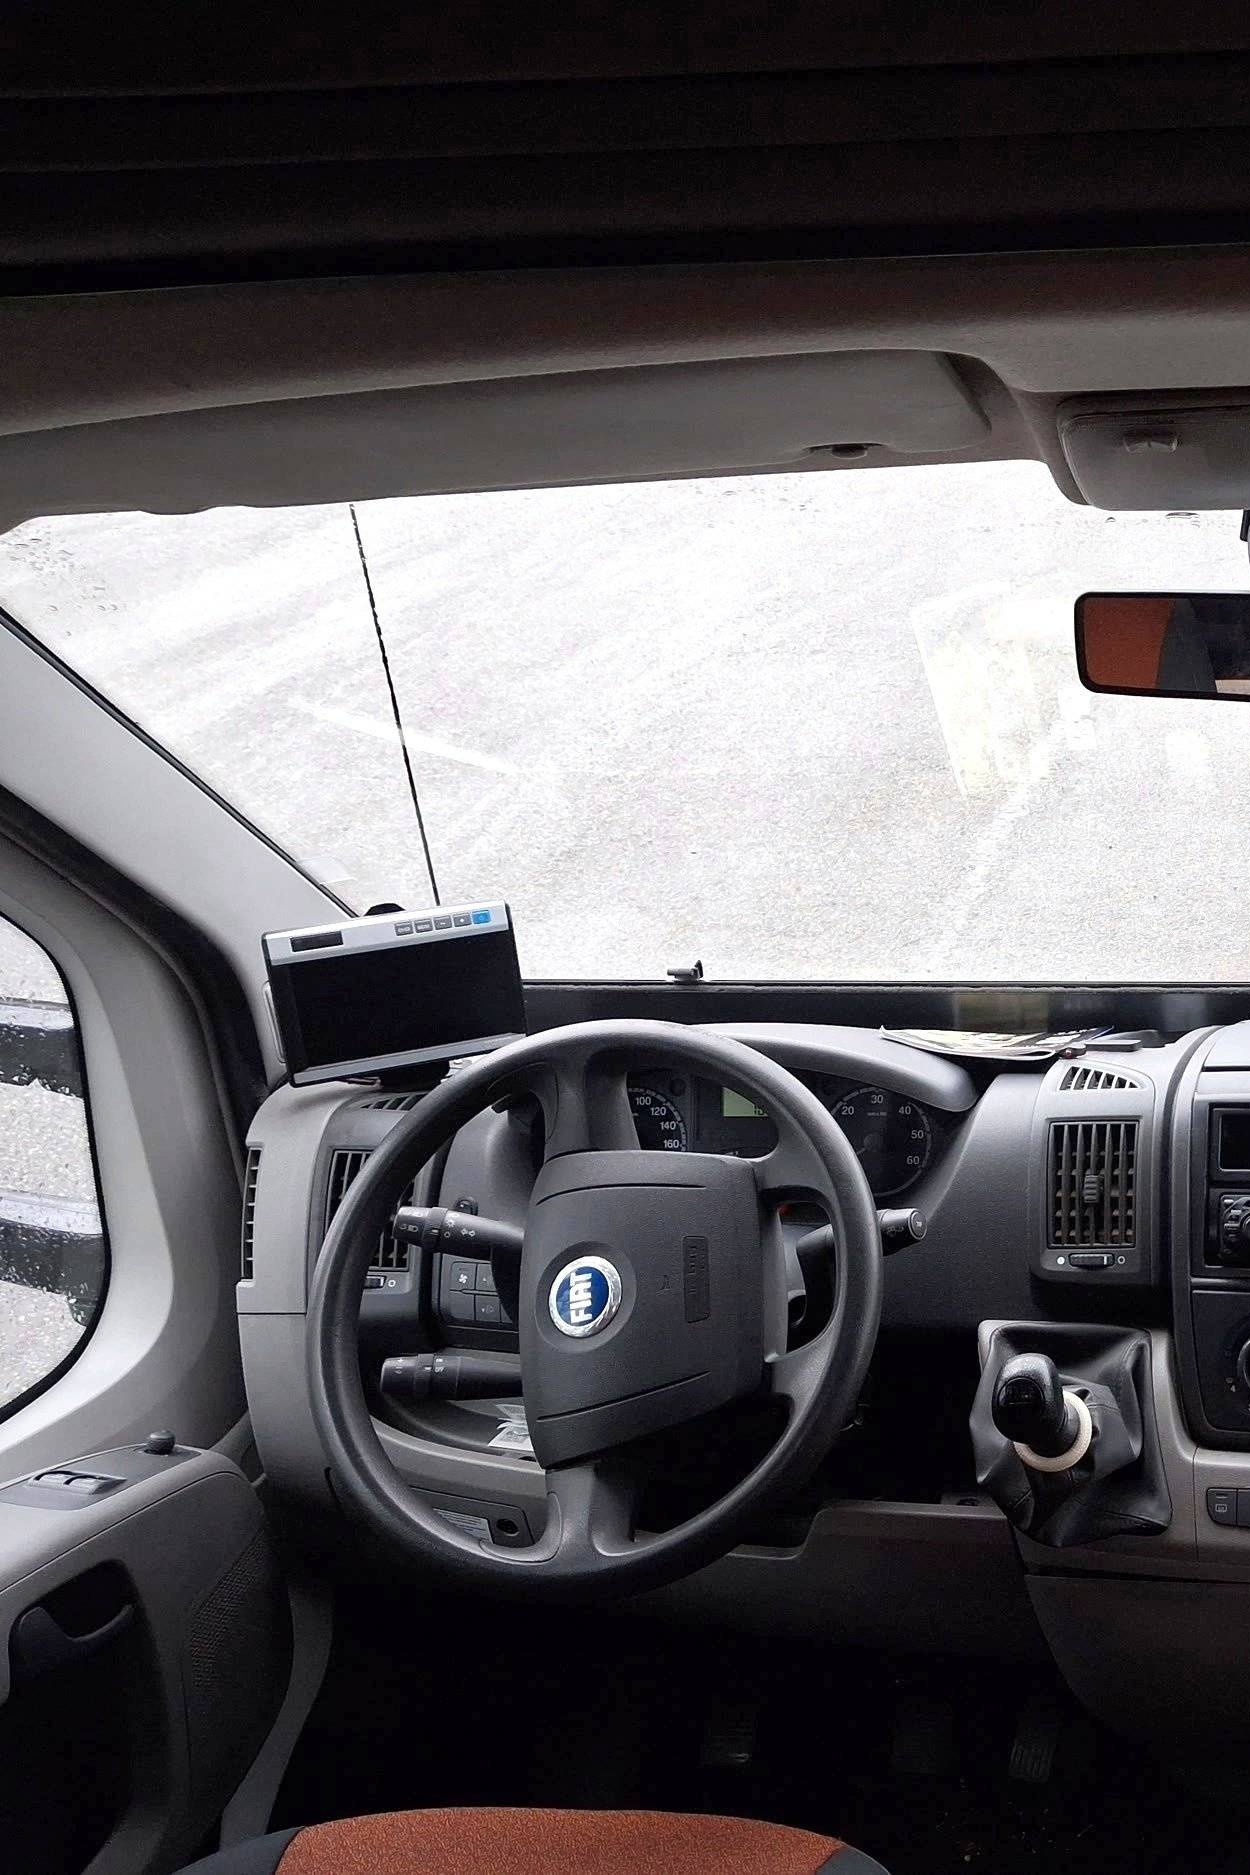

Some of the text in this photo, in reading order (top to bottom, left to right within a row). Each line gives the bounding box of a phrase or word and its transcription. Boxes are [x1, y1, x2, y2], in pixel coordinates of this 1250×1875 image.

[635, 1096, 652, 1106] 100
[871, 1094, 884, 1104] 30
[650, 1106, 667, 1116] 120
[841, 1106, 855, 1116] 20
[898, 1106, 912, 1116] 40
[660, 1121, 676, 1130] 140
[911, 1130, 924, 1139] 50
[664, 1139, 680, 1149] 160
[906, 1156, 920, 1165] 60
[569, 1270, 593, 1324] FIAT
